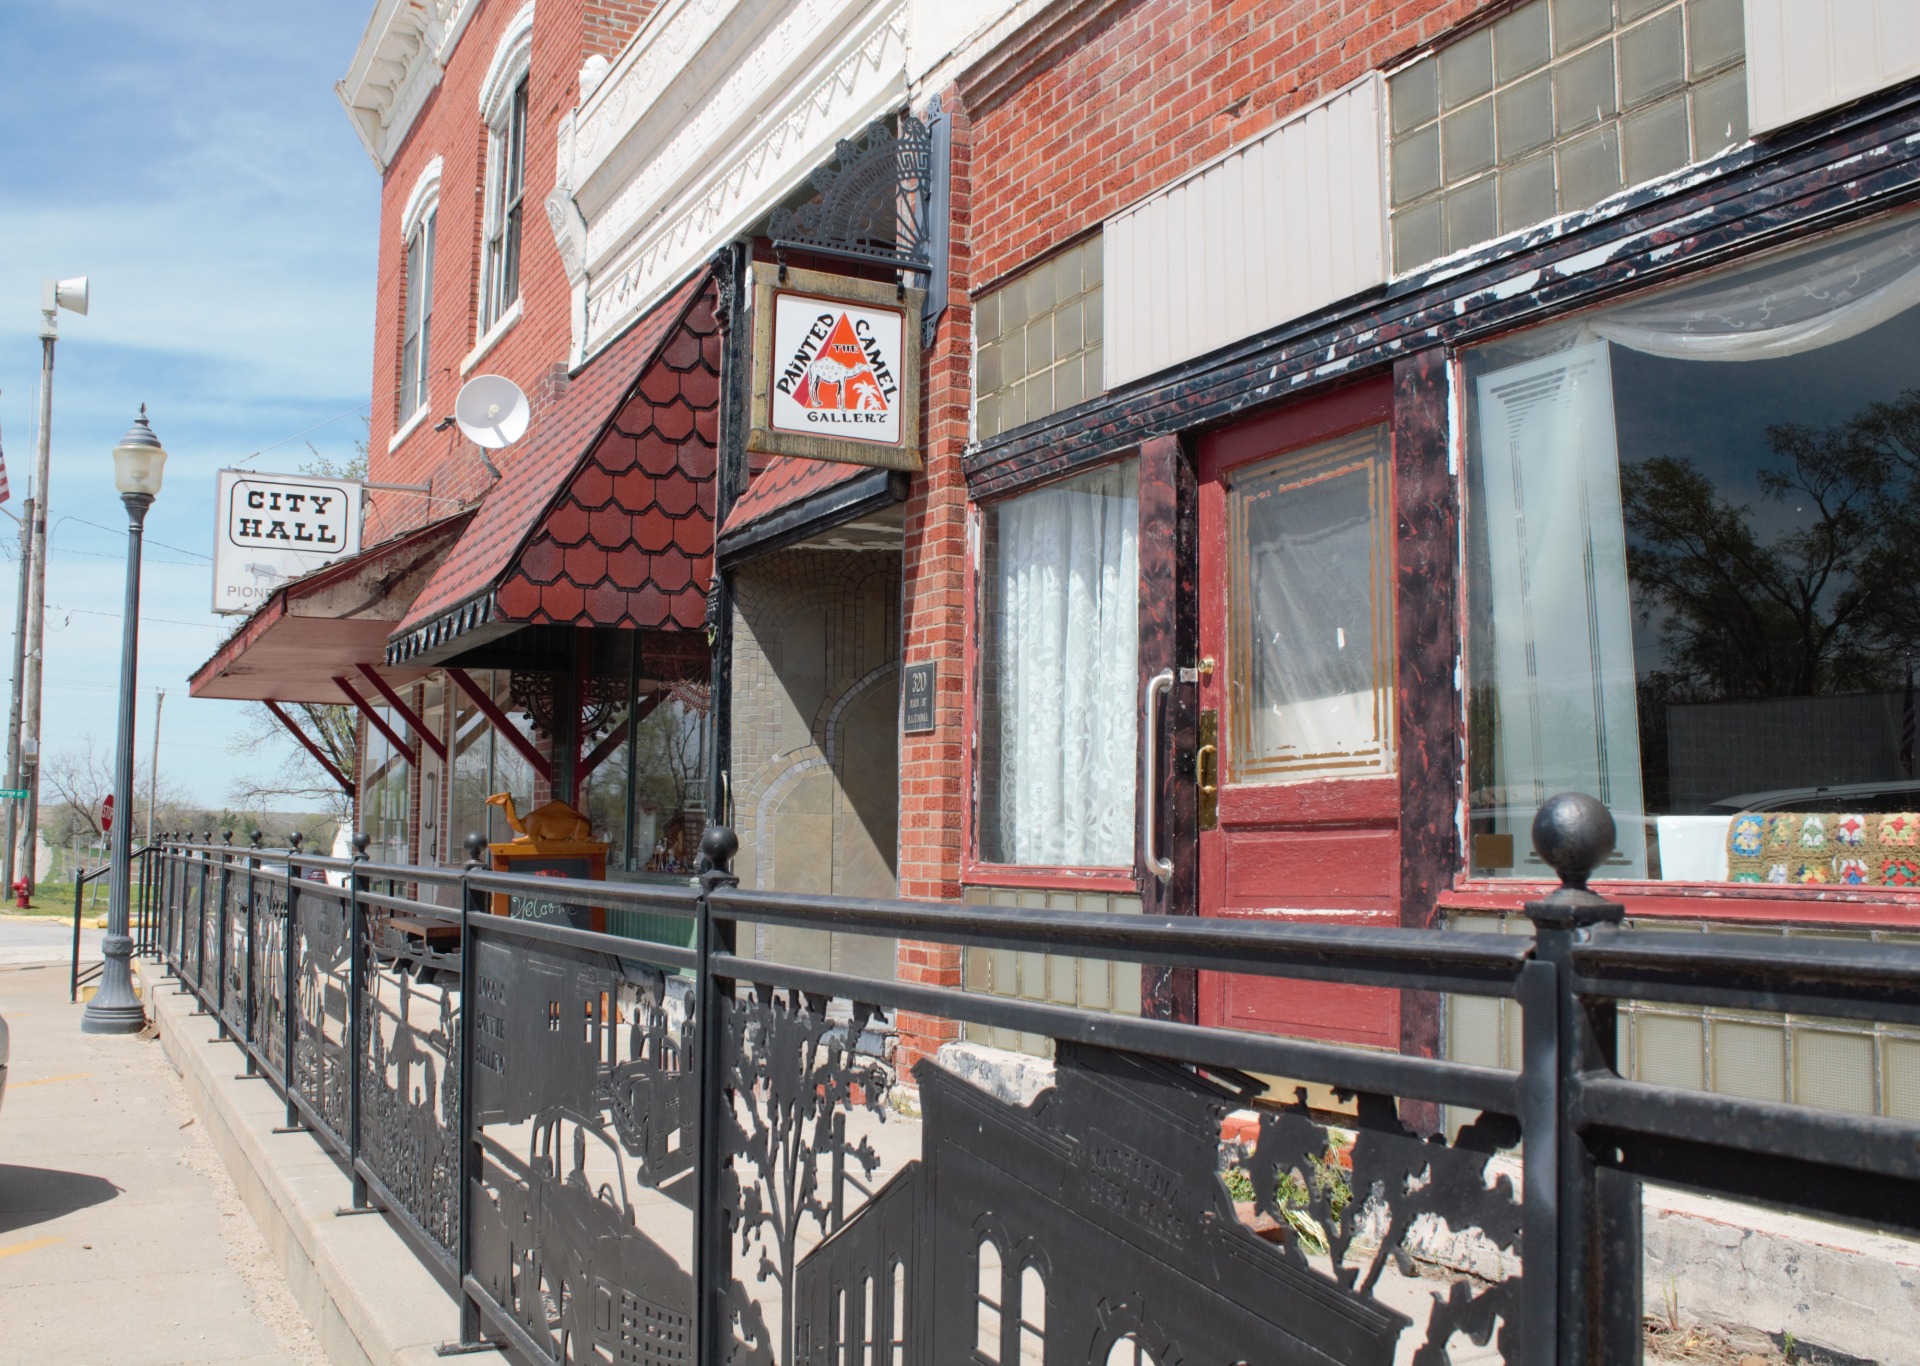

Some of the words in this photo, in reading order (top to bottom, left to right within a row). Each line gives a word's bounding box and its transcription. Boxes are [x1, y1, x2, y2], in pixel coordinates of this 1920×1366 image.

[832, 344, 859, 354] THE
[855, 319, 897, 403] CAMEL
[807, 411, 888, 423] GALLERY
[248, 490, 332, 514] CITY
[239, 518, 336, 543] HALL
[102, 804, 113, 819] STOP
[510, 896, 578, 920] Welcome
